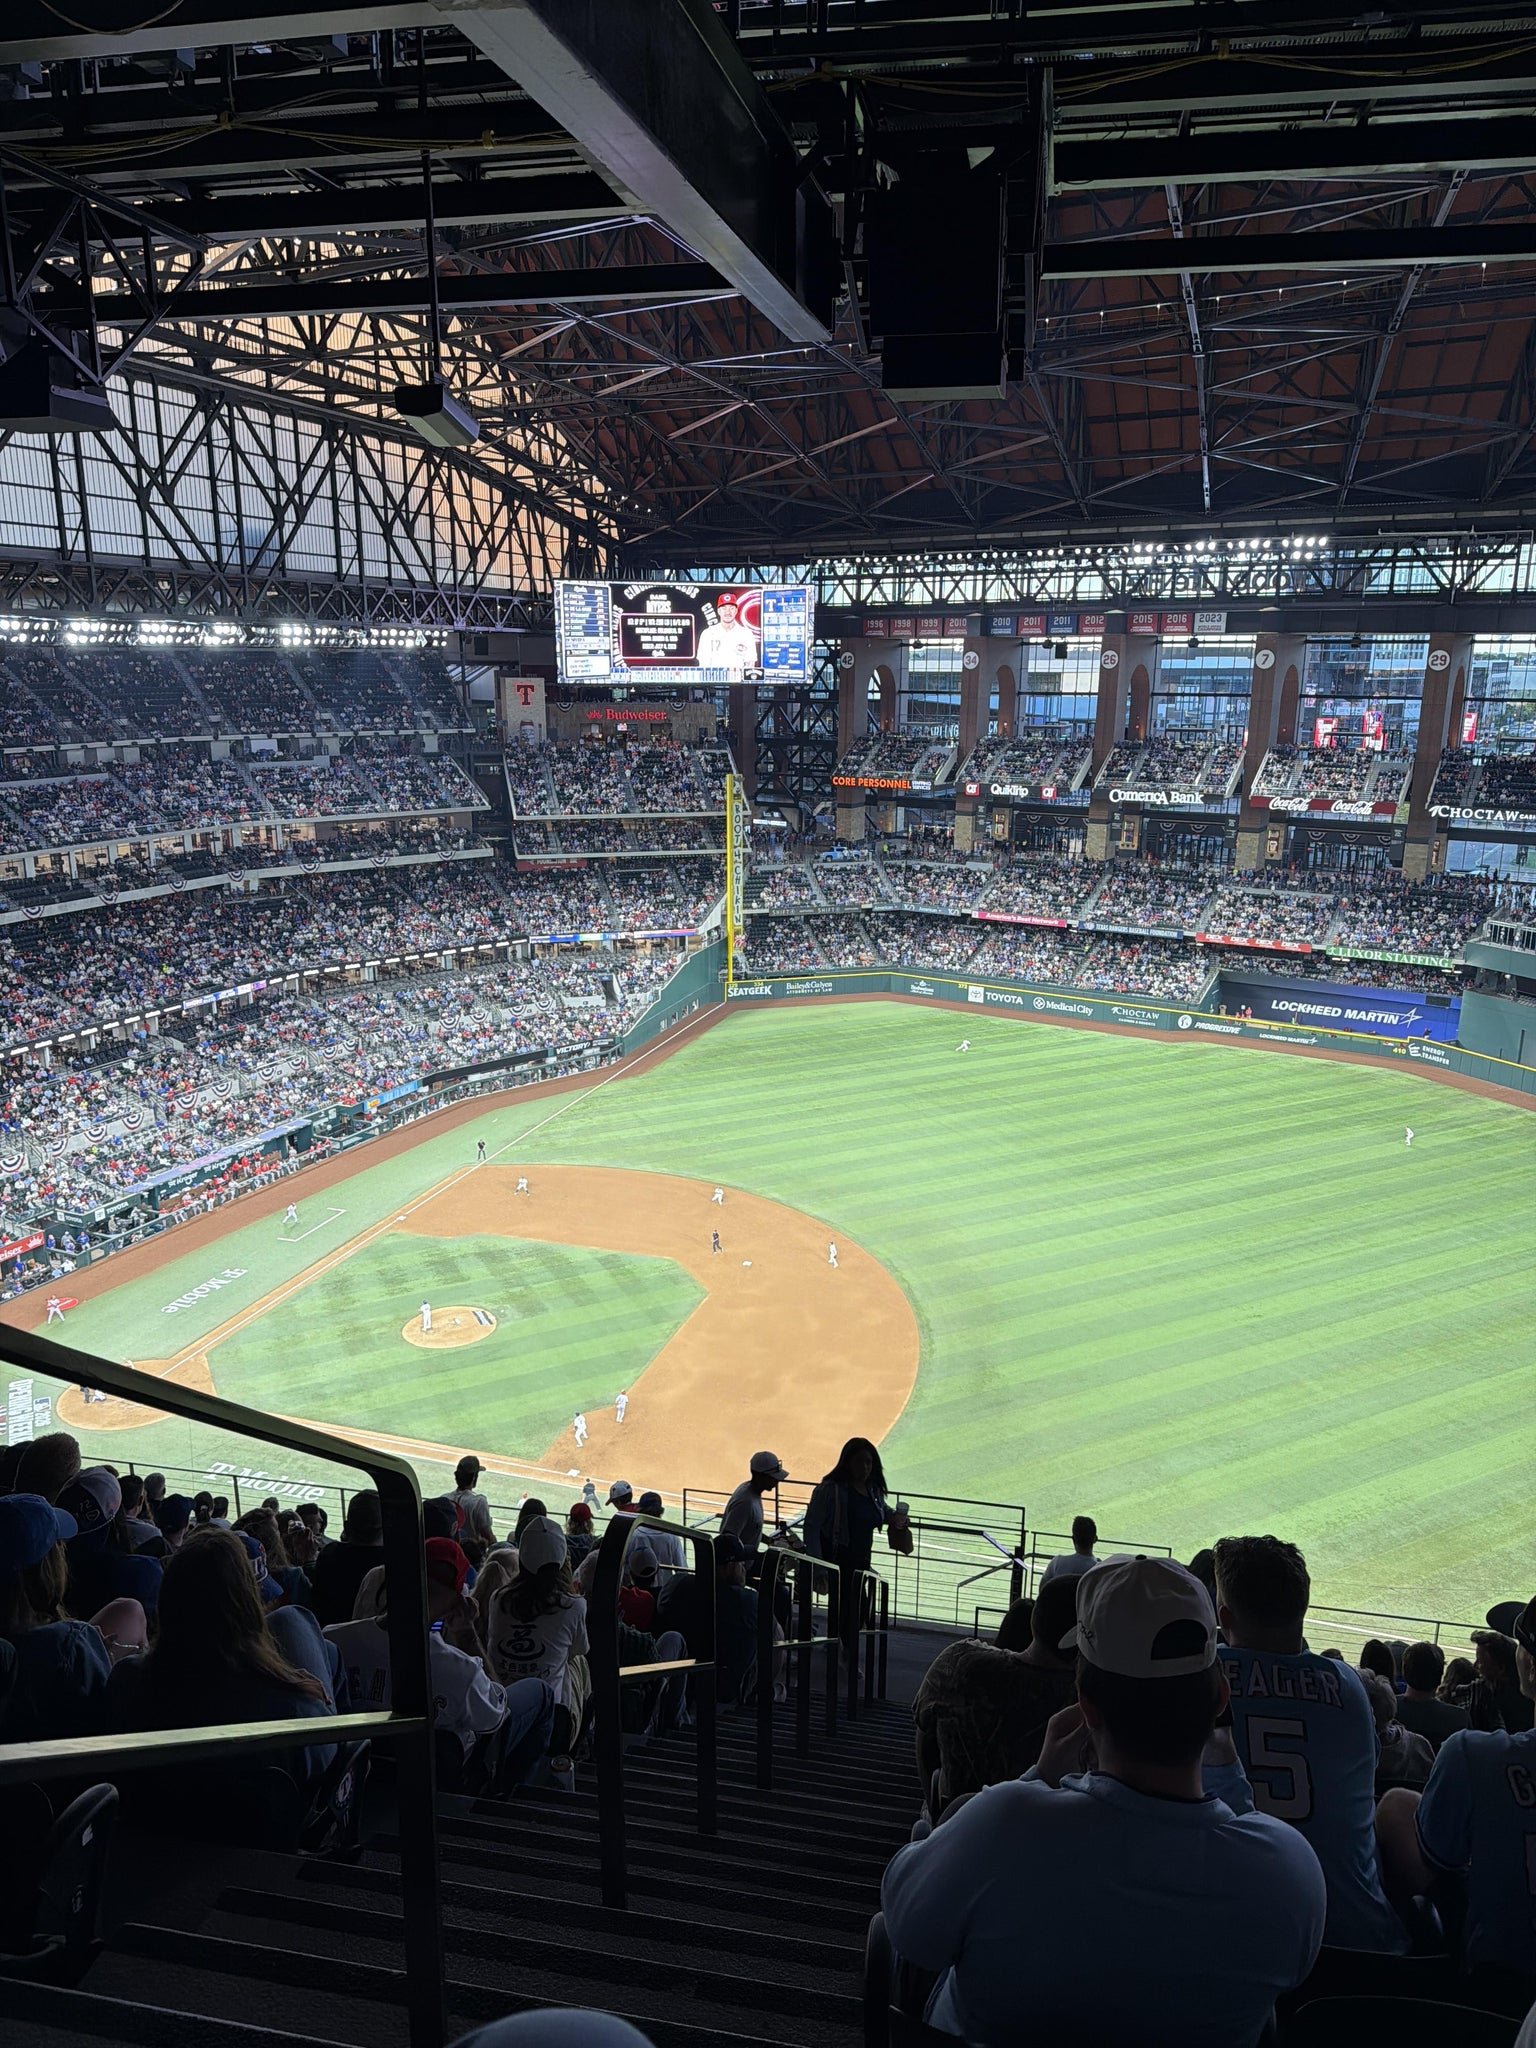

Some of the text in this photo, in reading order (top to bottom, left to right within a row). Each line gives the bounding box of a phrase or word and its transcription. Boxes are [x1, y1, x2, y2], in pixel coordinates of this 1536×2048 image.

[894, 620, 911, 628] 1998
[921, 619, 937, 627] 1999
[949, 618, 967, 627] 2010
[992, 617, 1011, 626] 2010
[1024, 617, 1040, 626] 2011
[1053, 616, 1071, 625] 2011
[1085, 616, 1105, 625] 2012
[1133, 614, 1153, 624] 2015
[1167, 614, 1187, 624] 2016
[1199, 613, 1222, 623] 2023
[842, 655, 853, 665] 42
[965, 655, 978, 665] 34
[1103, 654, 1116, 665] 26
[1261, 654, 1270, 665] 7
[1431, 654, 1447, 666] 29
[515, 683, 535, 706] T
[605, 709, 667, 720] Budweiser
[832, 776, 912, 790] CORE PERSONNEL
[966, 784, 978, 794] QT
[990, 783, 1029, 798] QuikTrip
[1042, 787, 1054, 797] QT
[1170, 791, 1204, 804] Bank
[1437, 805, 1520, 821] CHOCTAW
[734, 865, 742, 924] CHIKIN
[985, 912, 1060, 926] America's Best Network
[1095, 923, 1178, 937] TEXAS RANGERS BASEBALL FOUNDATION
[1340, 947, 1450, 968] LUXOR STAFFING
[728, 985, 772, 997] SEATGEEK
[986, 992, 1024, 1005] TOYOTA
[1046, 1001, 1093, 1017] Medical City
[1116, 1007, 1160, 1020] CHOCTAW
[1271, 1000, 1400, 1025] LOCKHEED MARTIN
[1194, 1022, 1242, 1035] PROGRESSIVE
[1259, 1033, 1287, 1041] LOCKHEED
[556, 1041, 588, 1055] VICTORY
[1392, 1047, 1407, 1055] 410
[1422, 1045, 1445, 1057] ENERGY
[1421, 1052, 1450, 1065] TRANSFER
[245, 1145, 265, 1157] Kroger
[210, 1158, 233, 1171] Kroger
[176, 1171, 199, 1186] Kroger
[106, 1201, 130, 1214] TOYOTA
[64, 1214, 83, 1224] TOYOTA
[8, 1378, 34, 1415] OPENING
[1246, 1713, 1314, 1822] 5
